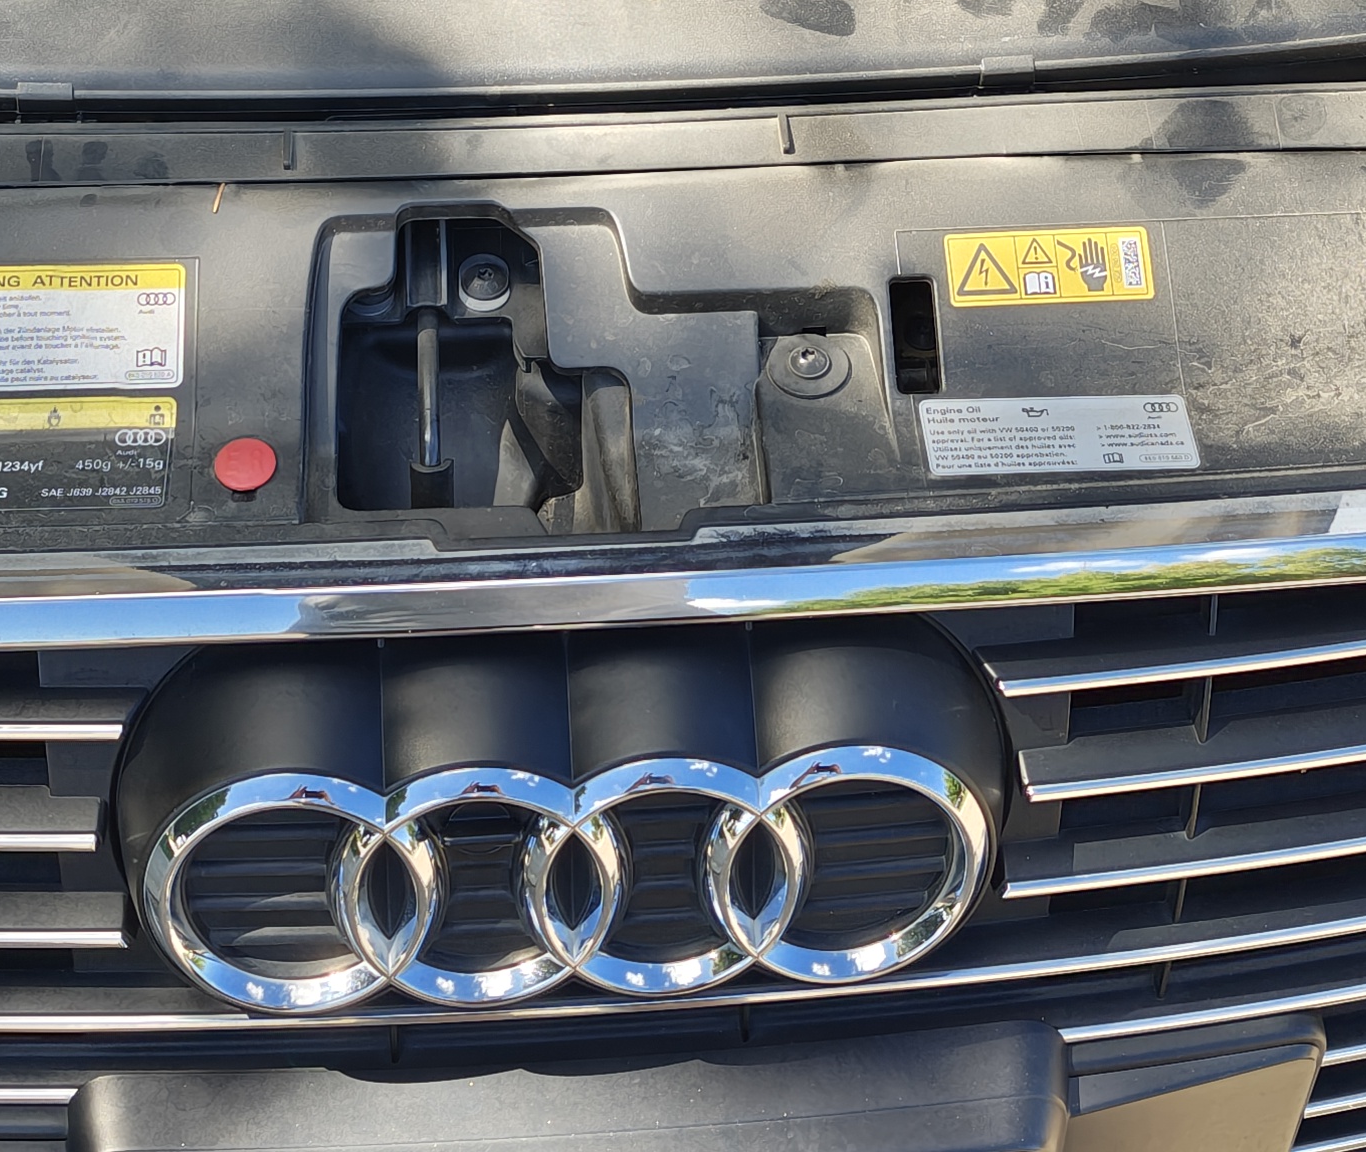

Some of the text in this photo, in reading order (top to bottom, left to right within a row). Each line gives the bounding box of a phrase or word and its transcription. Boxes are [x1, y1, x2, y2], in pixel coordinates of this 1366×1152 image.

[32, 274, 139, 288] ATTENTION
[926, 407, 963, 415] Engine
[947, 428, 964, 436] only
[75, 459, 111, 471] 450g
[117, 459, 164, 471] +/-15g
[41, 489, 63, 497] SAE
[95, 487, 127, 496] J2842
[129, 486, 161, 496] J2845
